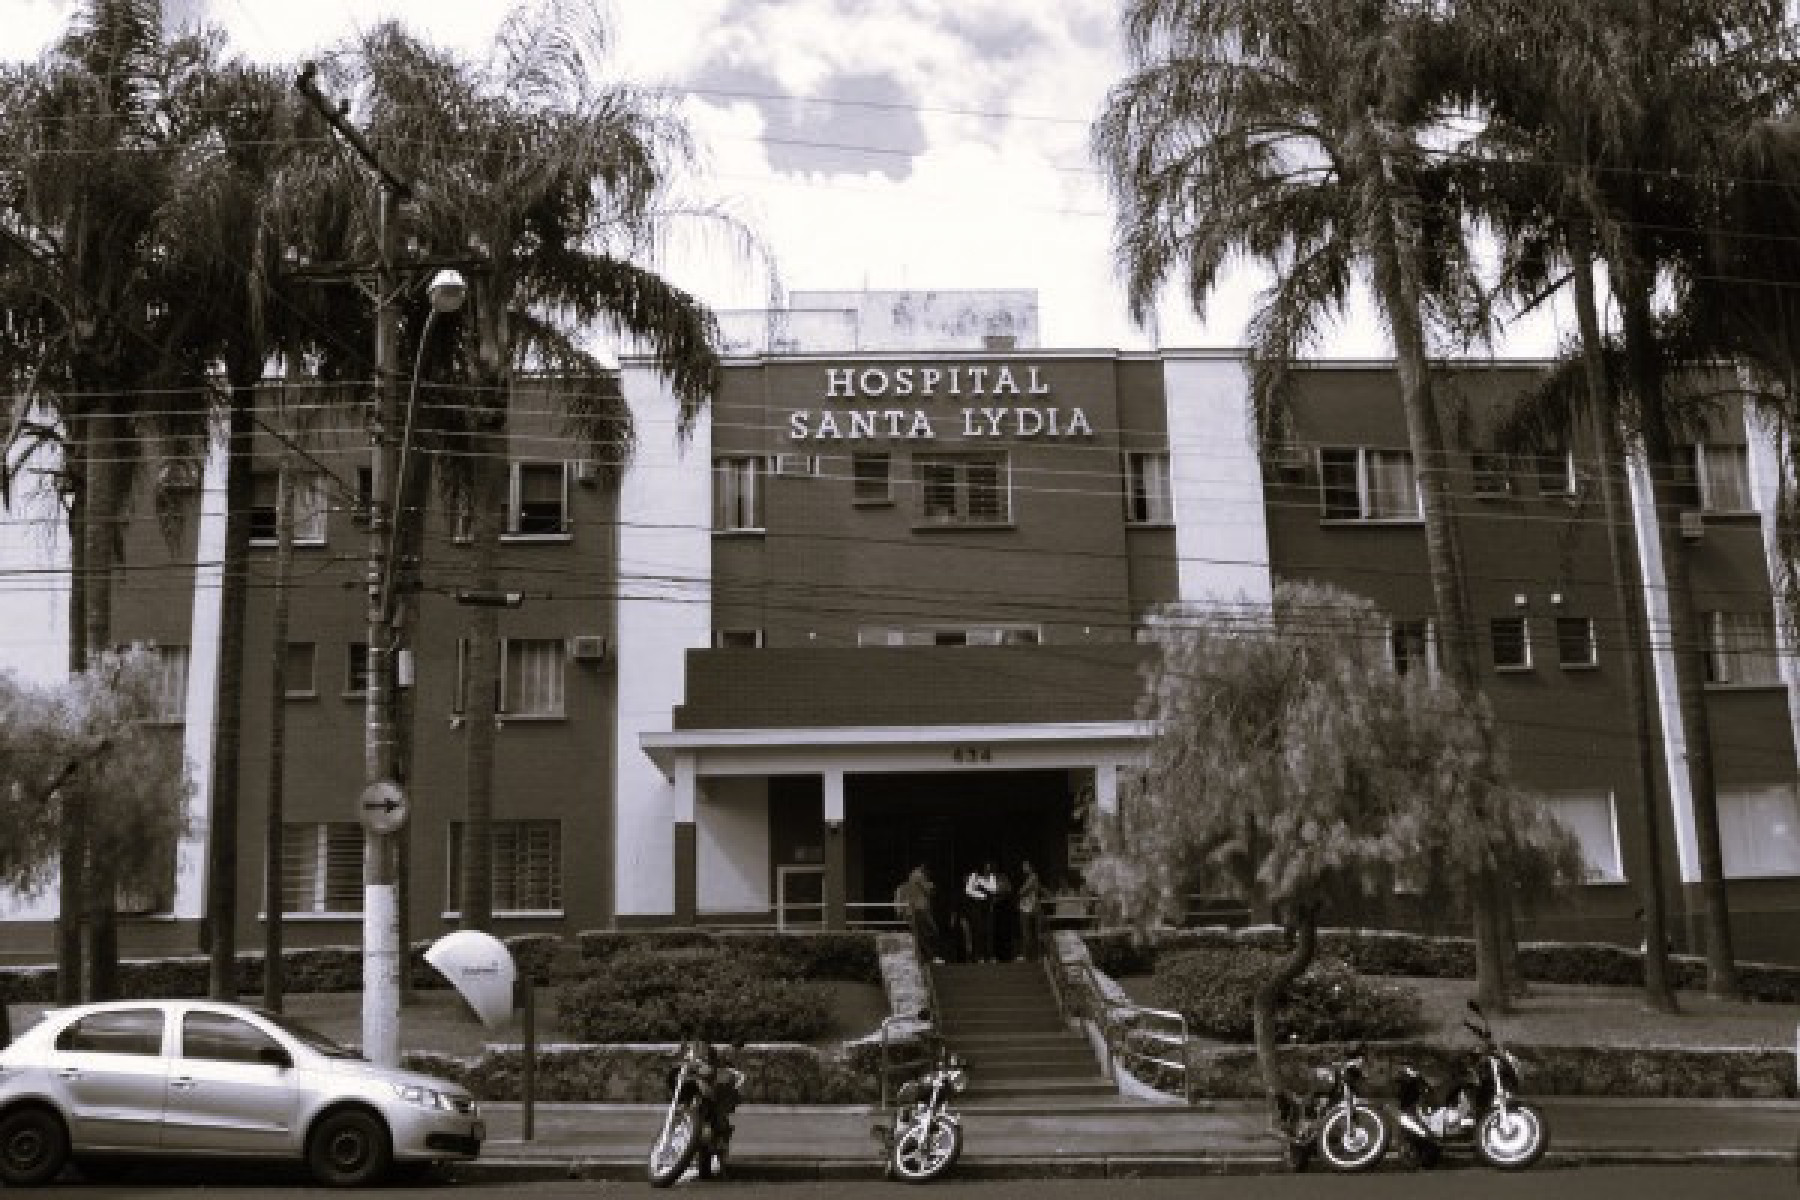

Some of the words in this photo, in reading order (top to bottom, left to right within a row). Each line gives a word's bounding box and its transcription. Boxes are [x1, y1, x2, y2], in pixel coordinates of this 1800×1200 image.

[825, 365, 1049, 398] HOSPITAL
[789, 408, 937, 440] SANTA
[962, 407, 1094, 437] LYDIA
